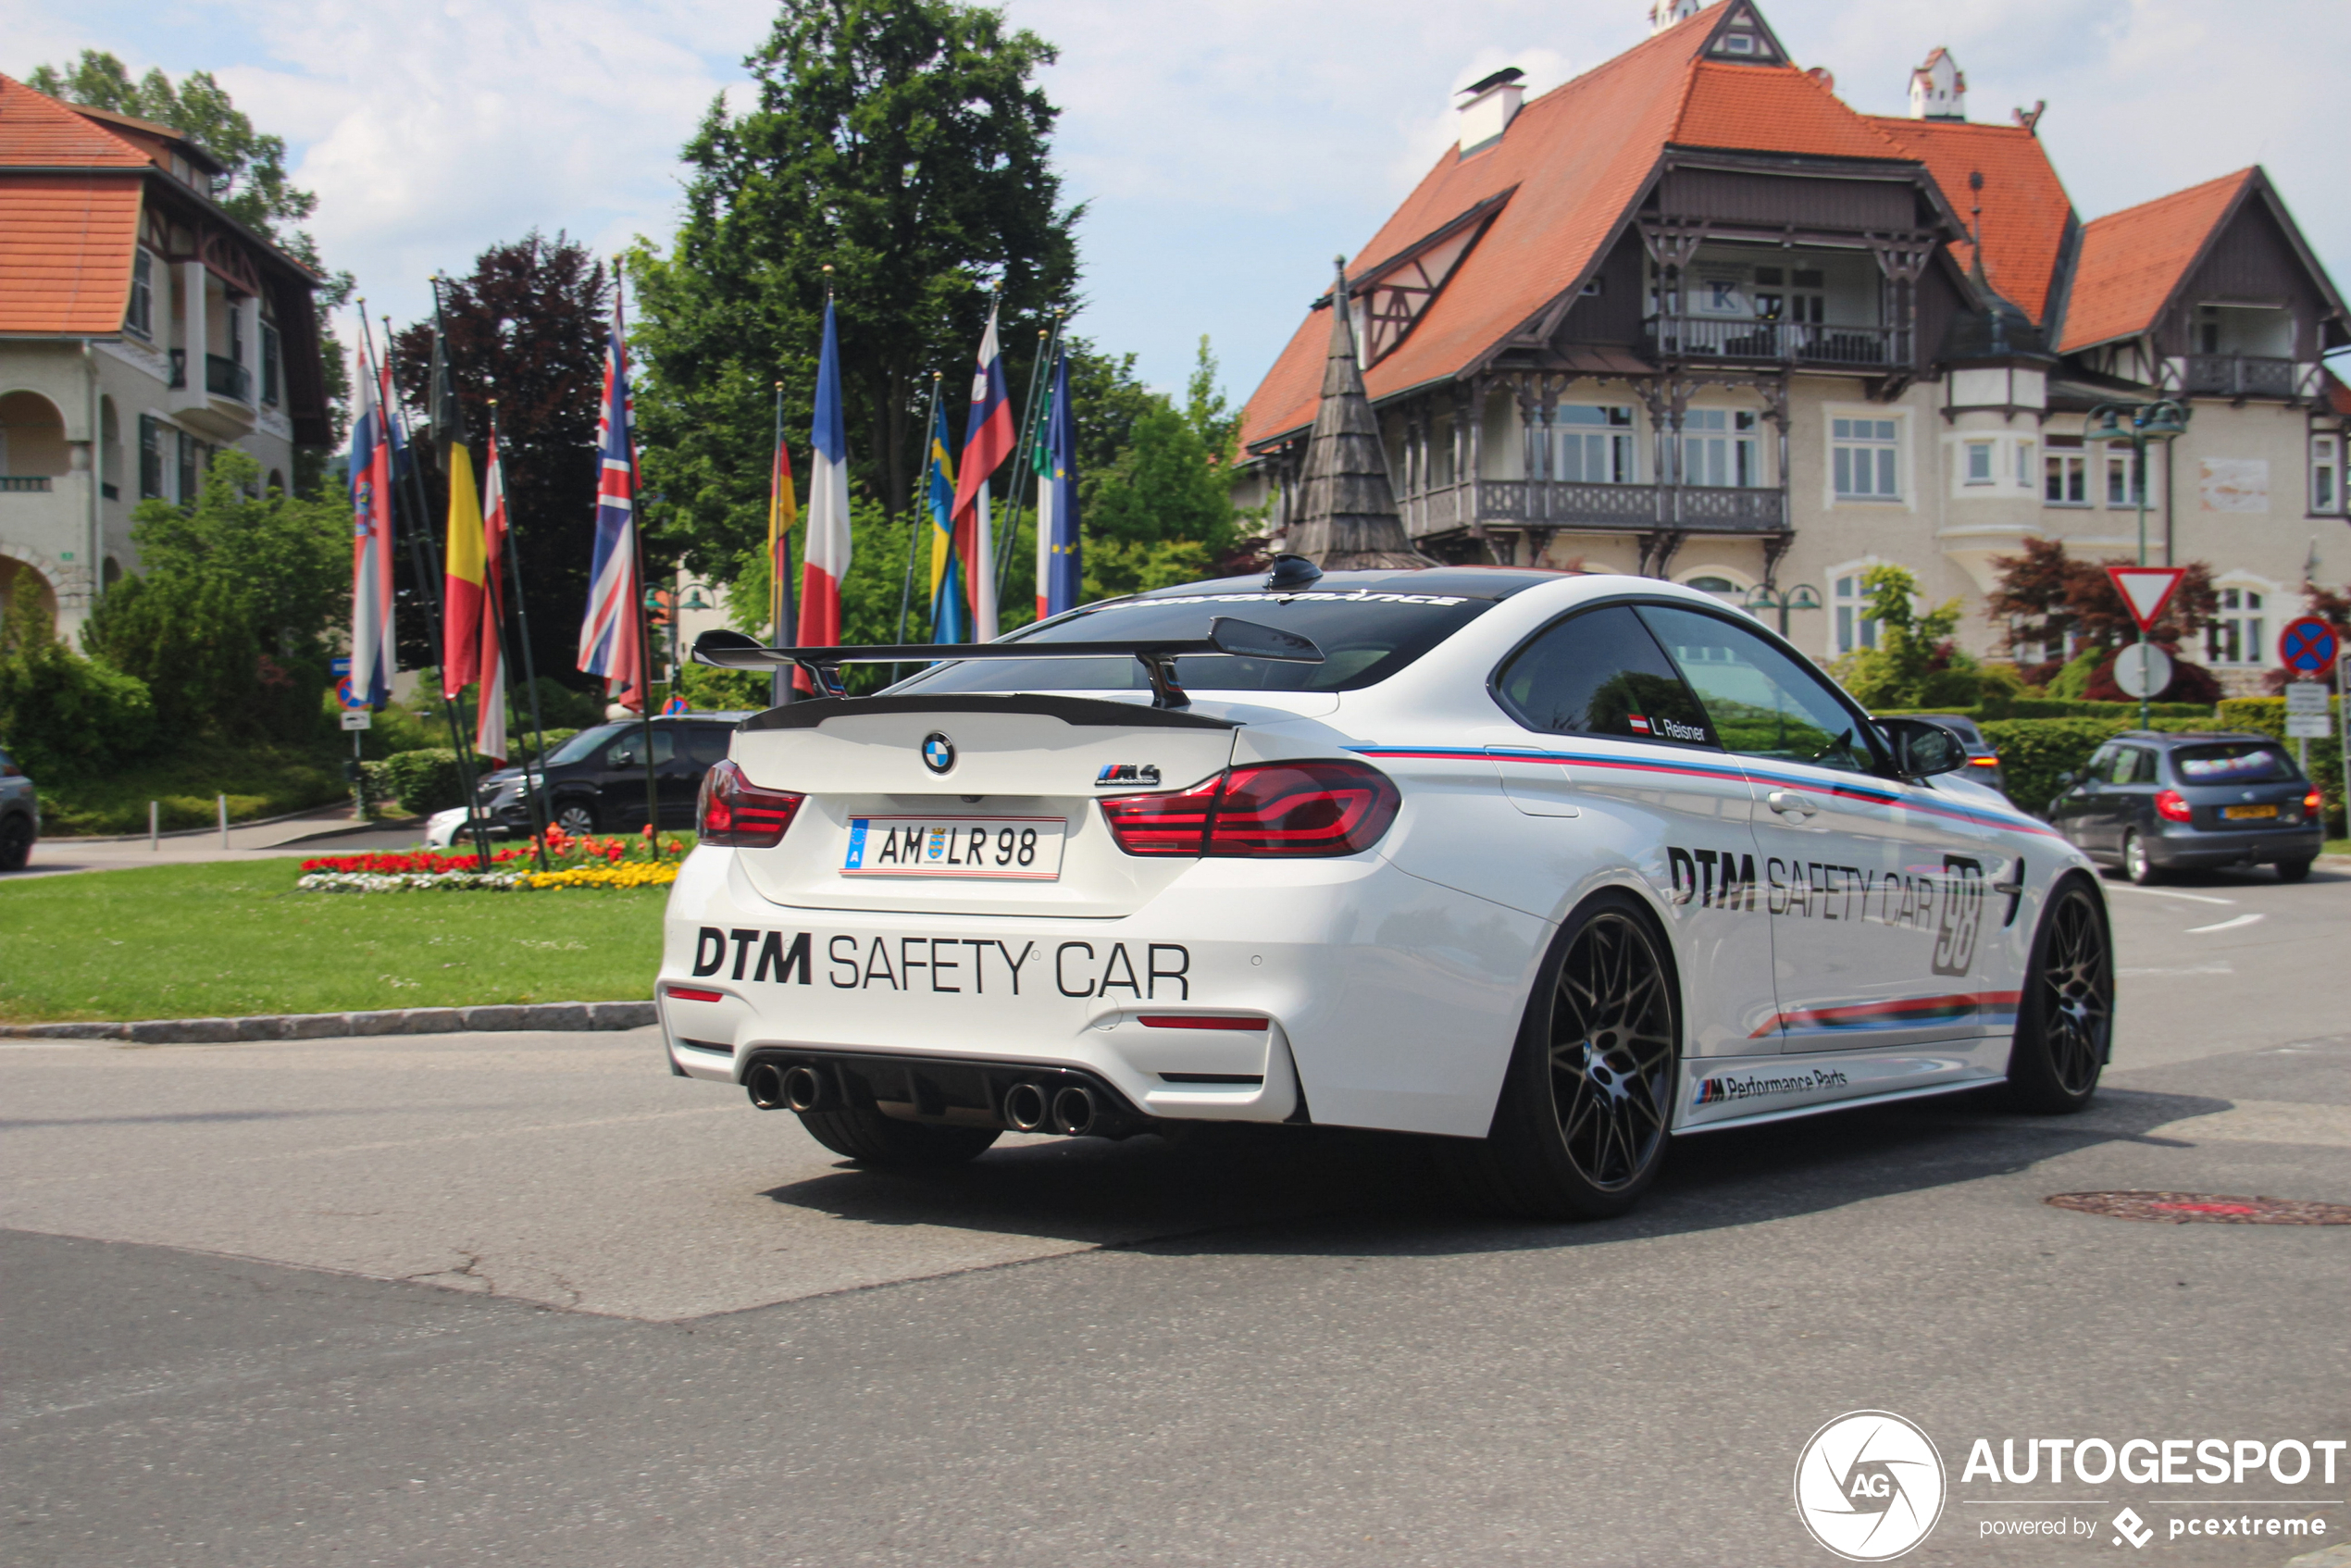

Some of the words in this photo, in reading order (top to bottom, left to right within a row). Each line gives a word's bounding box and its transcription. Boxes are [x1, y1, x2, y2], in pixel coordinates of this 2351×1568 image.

[1649, 717, 1664, 736] L.
[1663, 718, 1705, 740] Reisner
[1113, 764, 1161, 778] M4
[850, 851, 859, 863] A
[878, 827, 925, 864] AM
[948, 828, 987, 865] LR
[996, 828, 1037, 866] 98
[1667, 846, 1756, 912] DTM
[1767, 857, 1872, 922] SAFETY
[1883, 872, 1934, 930] CAR
[1934, 861, 1981, 970] 98
[692, 927, 813, 985] DTM
[828, 934, 1035, 996] SAFETY
[1056, 940, 1190, 1001] CAR
[1726, 1076, 1813, 1099] Performance
[1813, 1069, 1847, 1087] Parts
